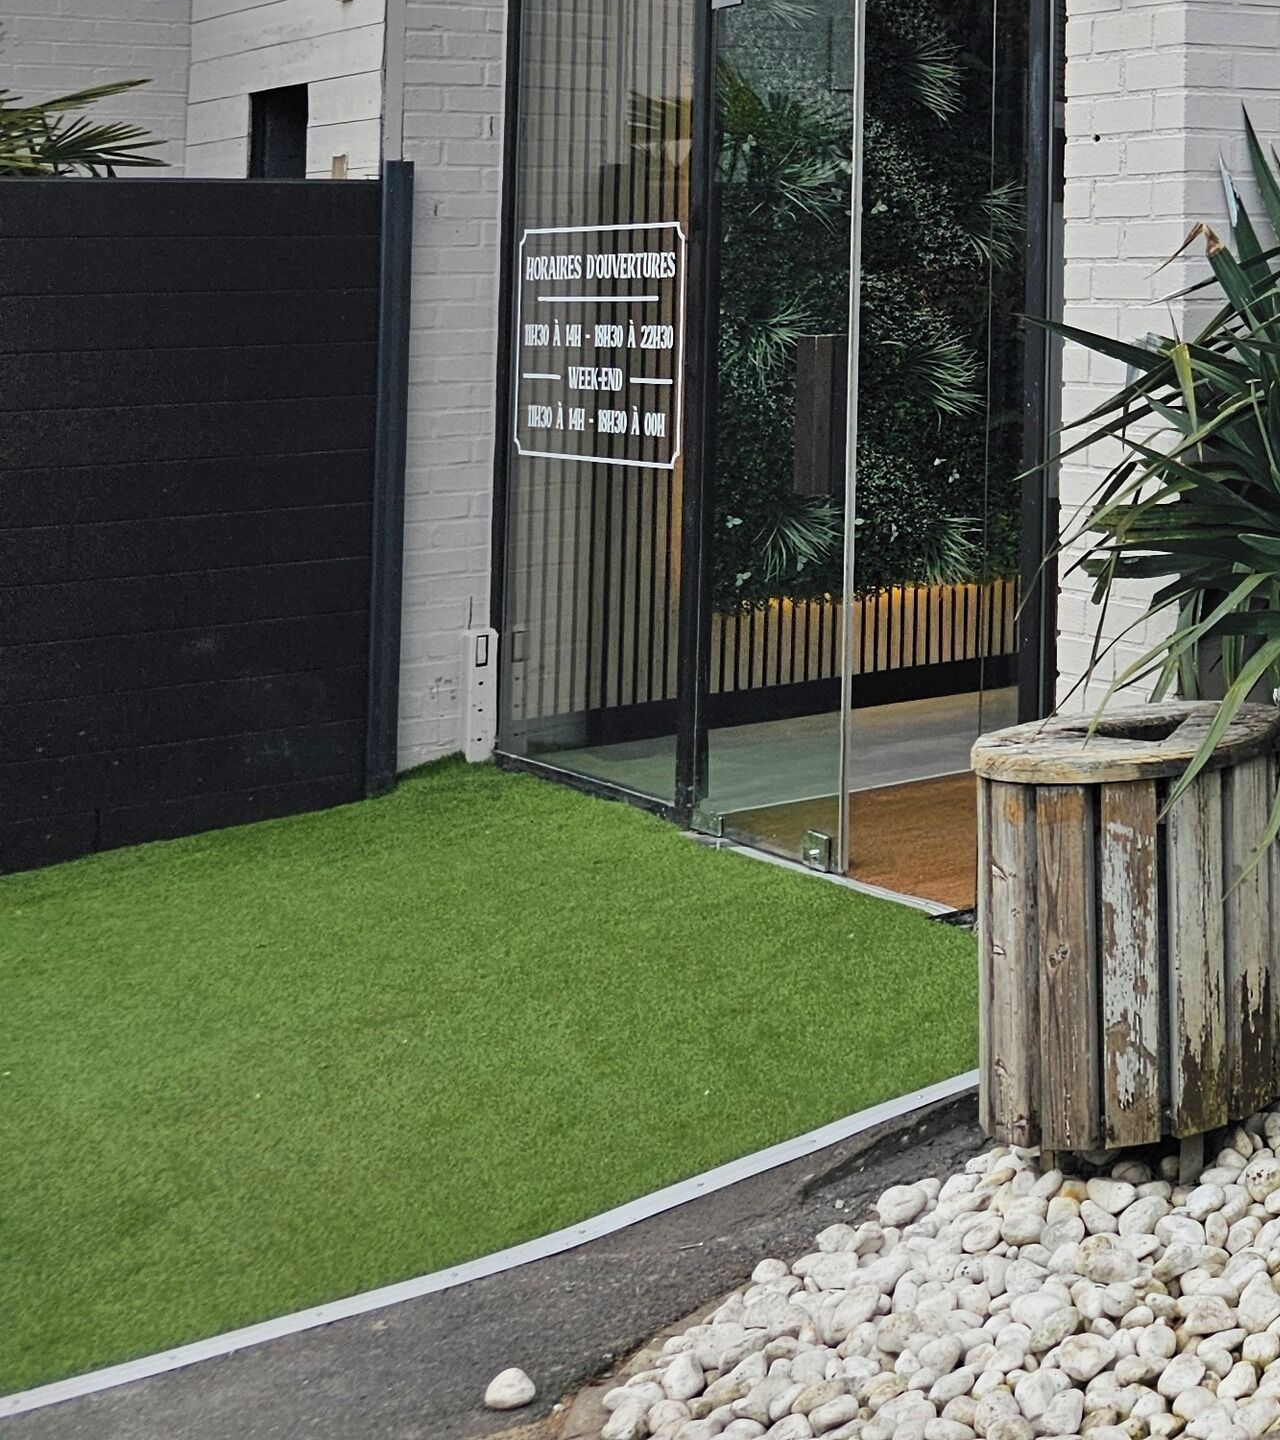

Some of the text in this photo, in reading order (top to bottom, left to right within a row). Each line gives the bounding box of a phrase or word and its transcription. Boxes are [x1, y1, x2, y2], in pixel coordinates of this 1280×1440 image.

[526, 252, 676, 281] HORAIRES D'OUVERTURES
[524, 323, 550, 347] 11H30
[552, 318, 561, 347] À
[565, 324, 582, 347] 14H
[594, 324, 624, 348] 18H30
[627, 319, 636, 348] À
[640, 324, 674, 349] 22H30
[567, 366, 623, 392] WEEK-END
[527, 404, 553, 428] 11H30
[555, 401, 564, 430] À
[568, 407, 585, 431] 14H
[597, 409, 628, 434] 18H30
[630, 406, 640, 436] À
